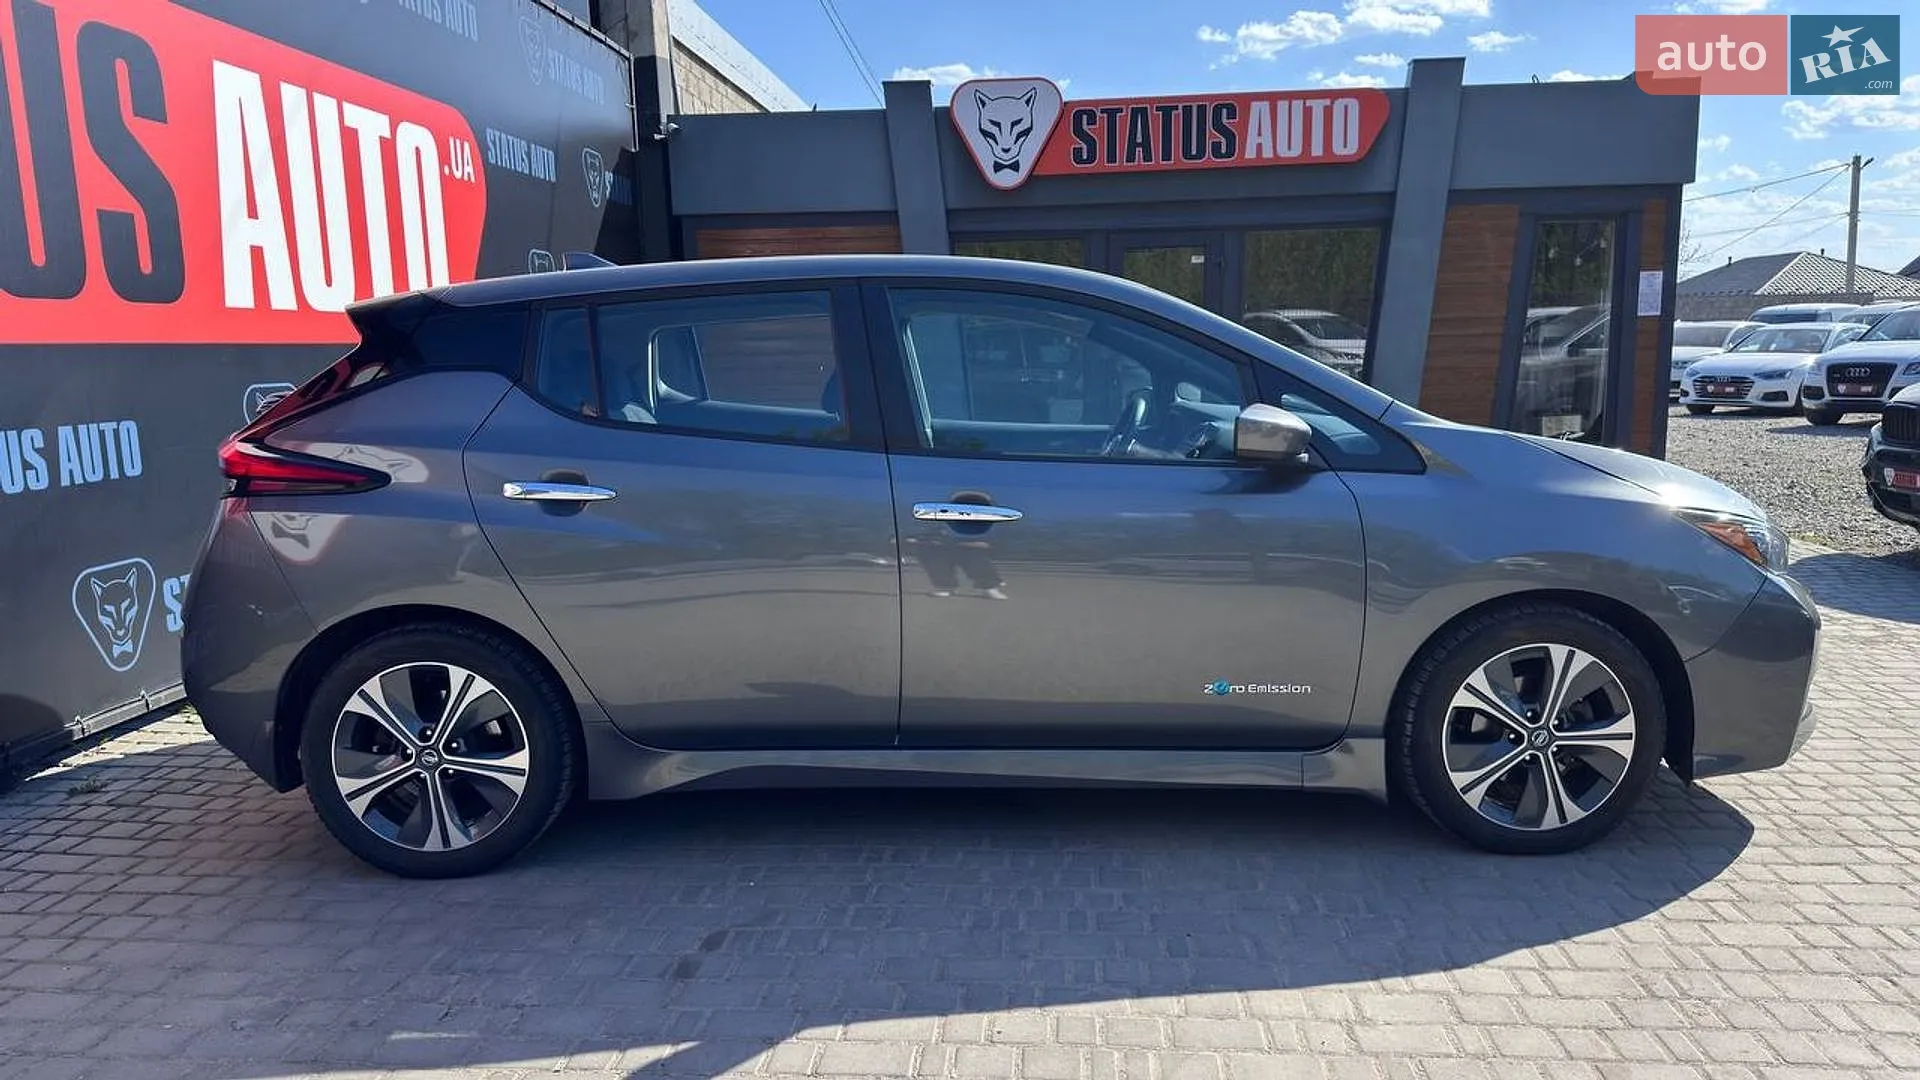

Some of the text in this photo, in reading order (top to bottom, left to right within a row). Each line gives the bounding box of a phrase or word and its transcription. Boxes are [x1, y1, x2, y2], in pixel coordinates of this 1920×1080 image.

[486, 127, 557, 183] STATUS AUTO
[1070, 98, 1360, 168] STATUS AUTO
[57, 420, 143, 487] AUTO
[163, 573, 191, 632] S
